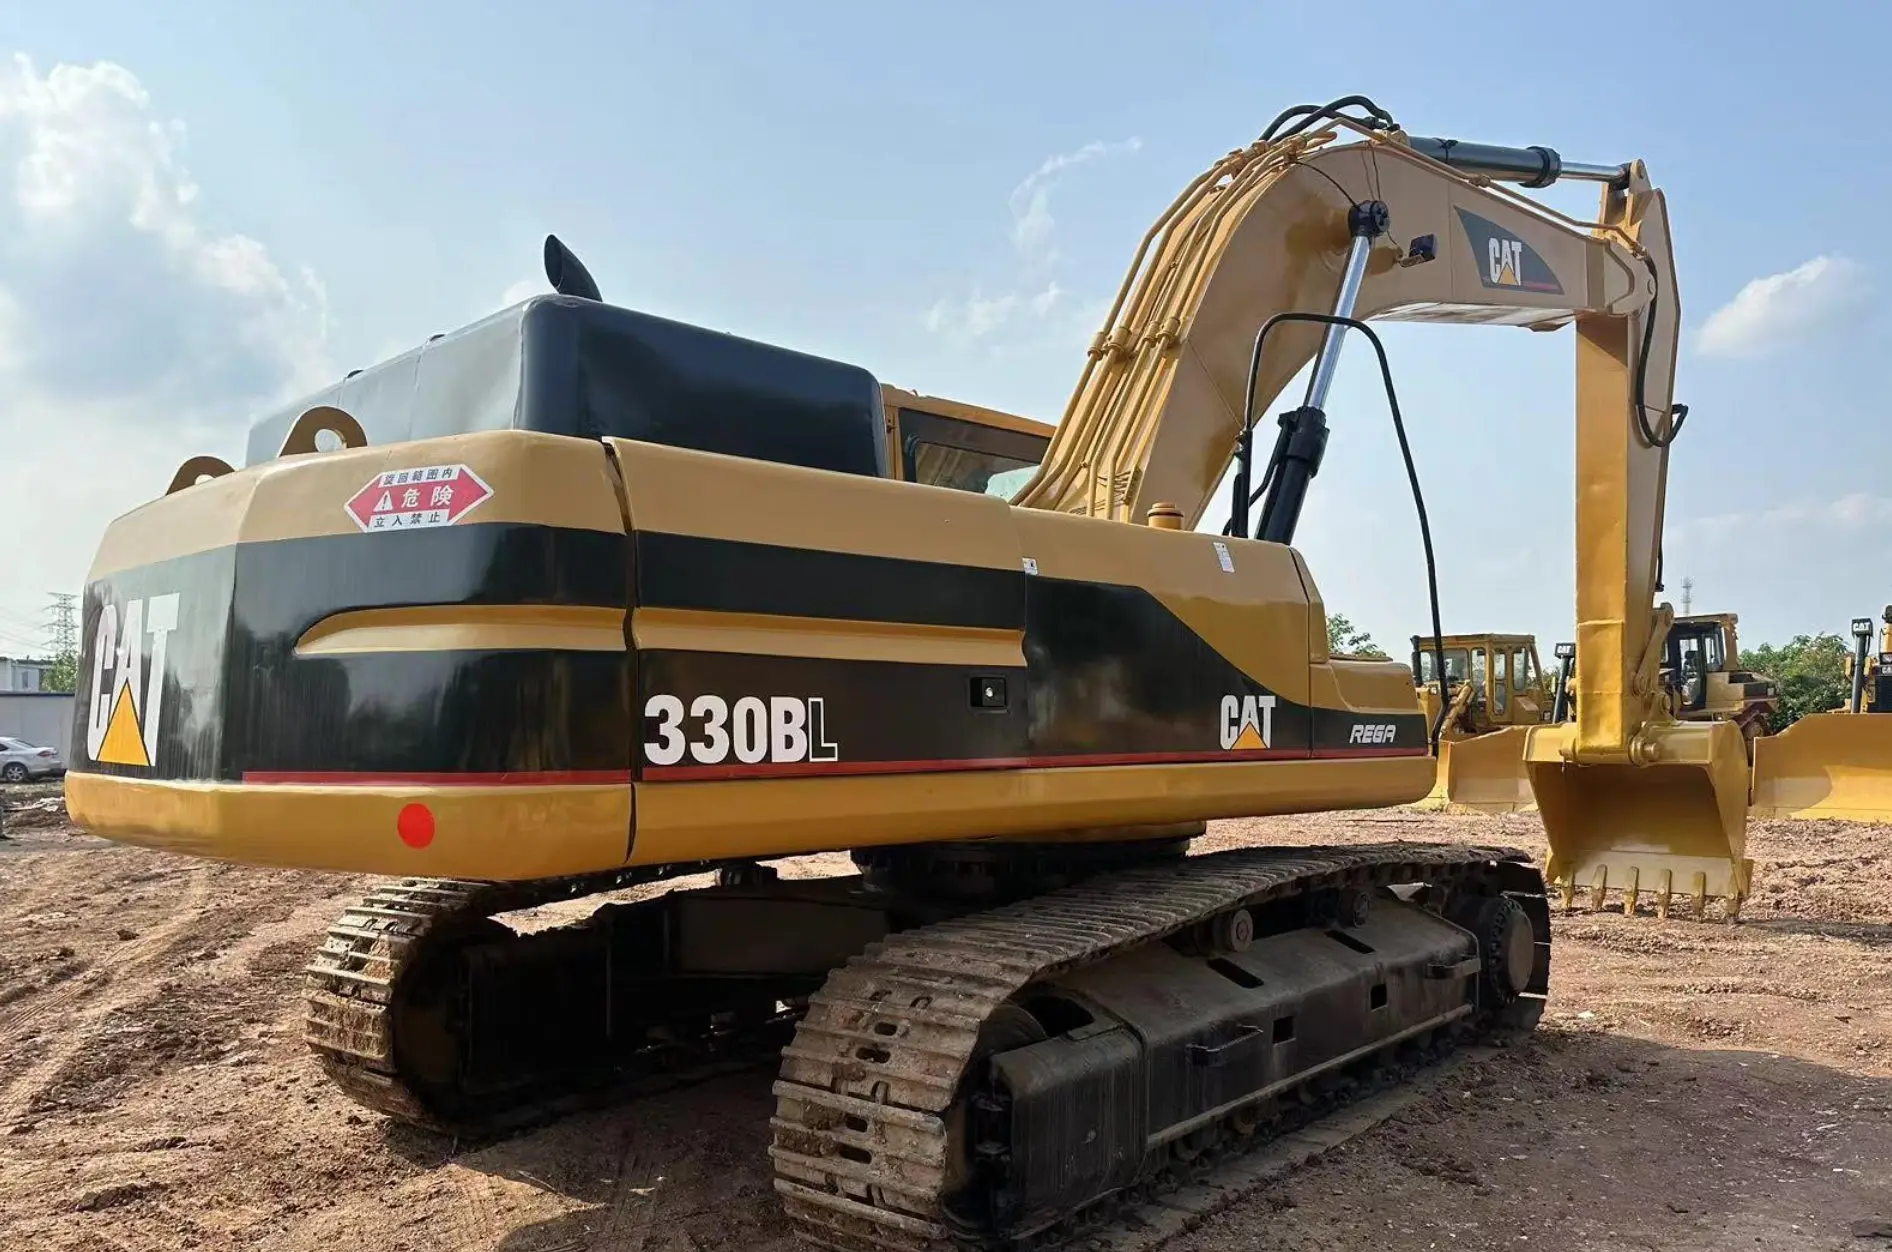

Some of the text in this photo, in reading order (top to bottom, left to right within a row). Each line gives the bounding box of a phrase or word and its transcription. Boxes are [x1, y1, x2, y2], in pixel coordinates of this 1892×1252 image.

[1488, 237, 1522, 285] CAT
[374, 512, 440, 527] 立入禁止
[1852, 622, 1870, 631] CAT
[88, 593, 180, 766] CAT
[1220, 694, 1276, 750] CAT
[1349, 724, 1397, 744] REGA
